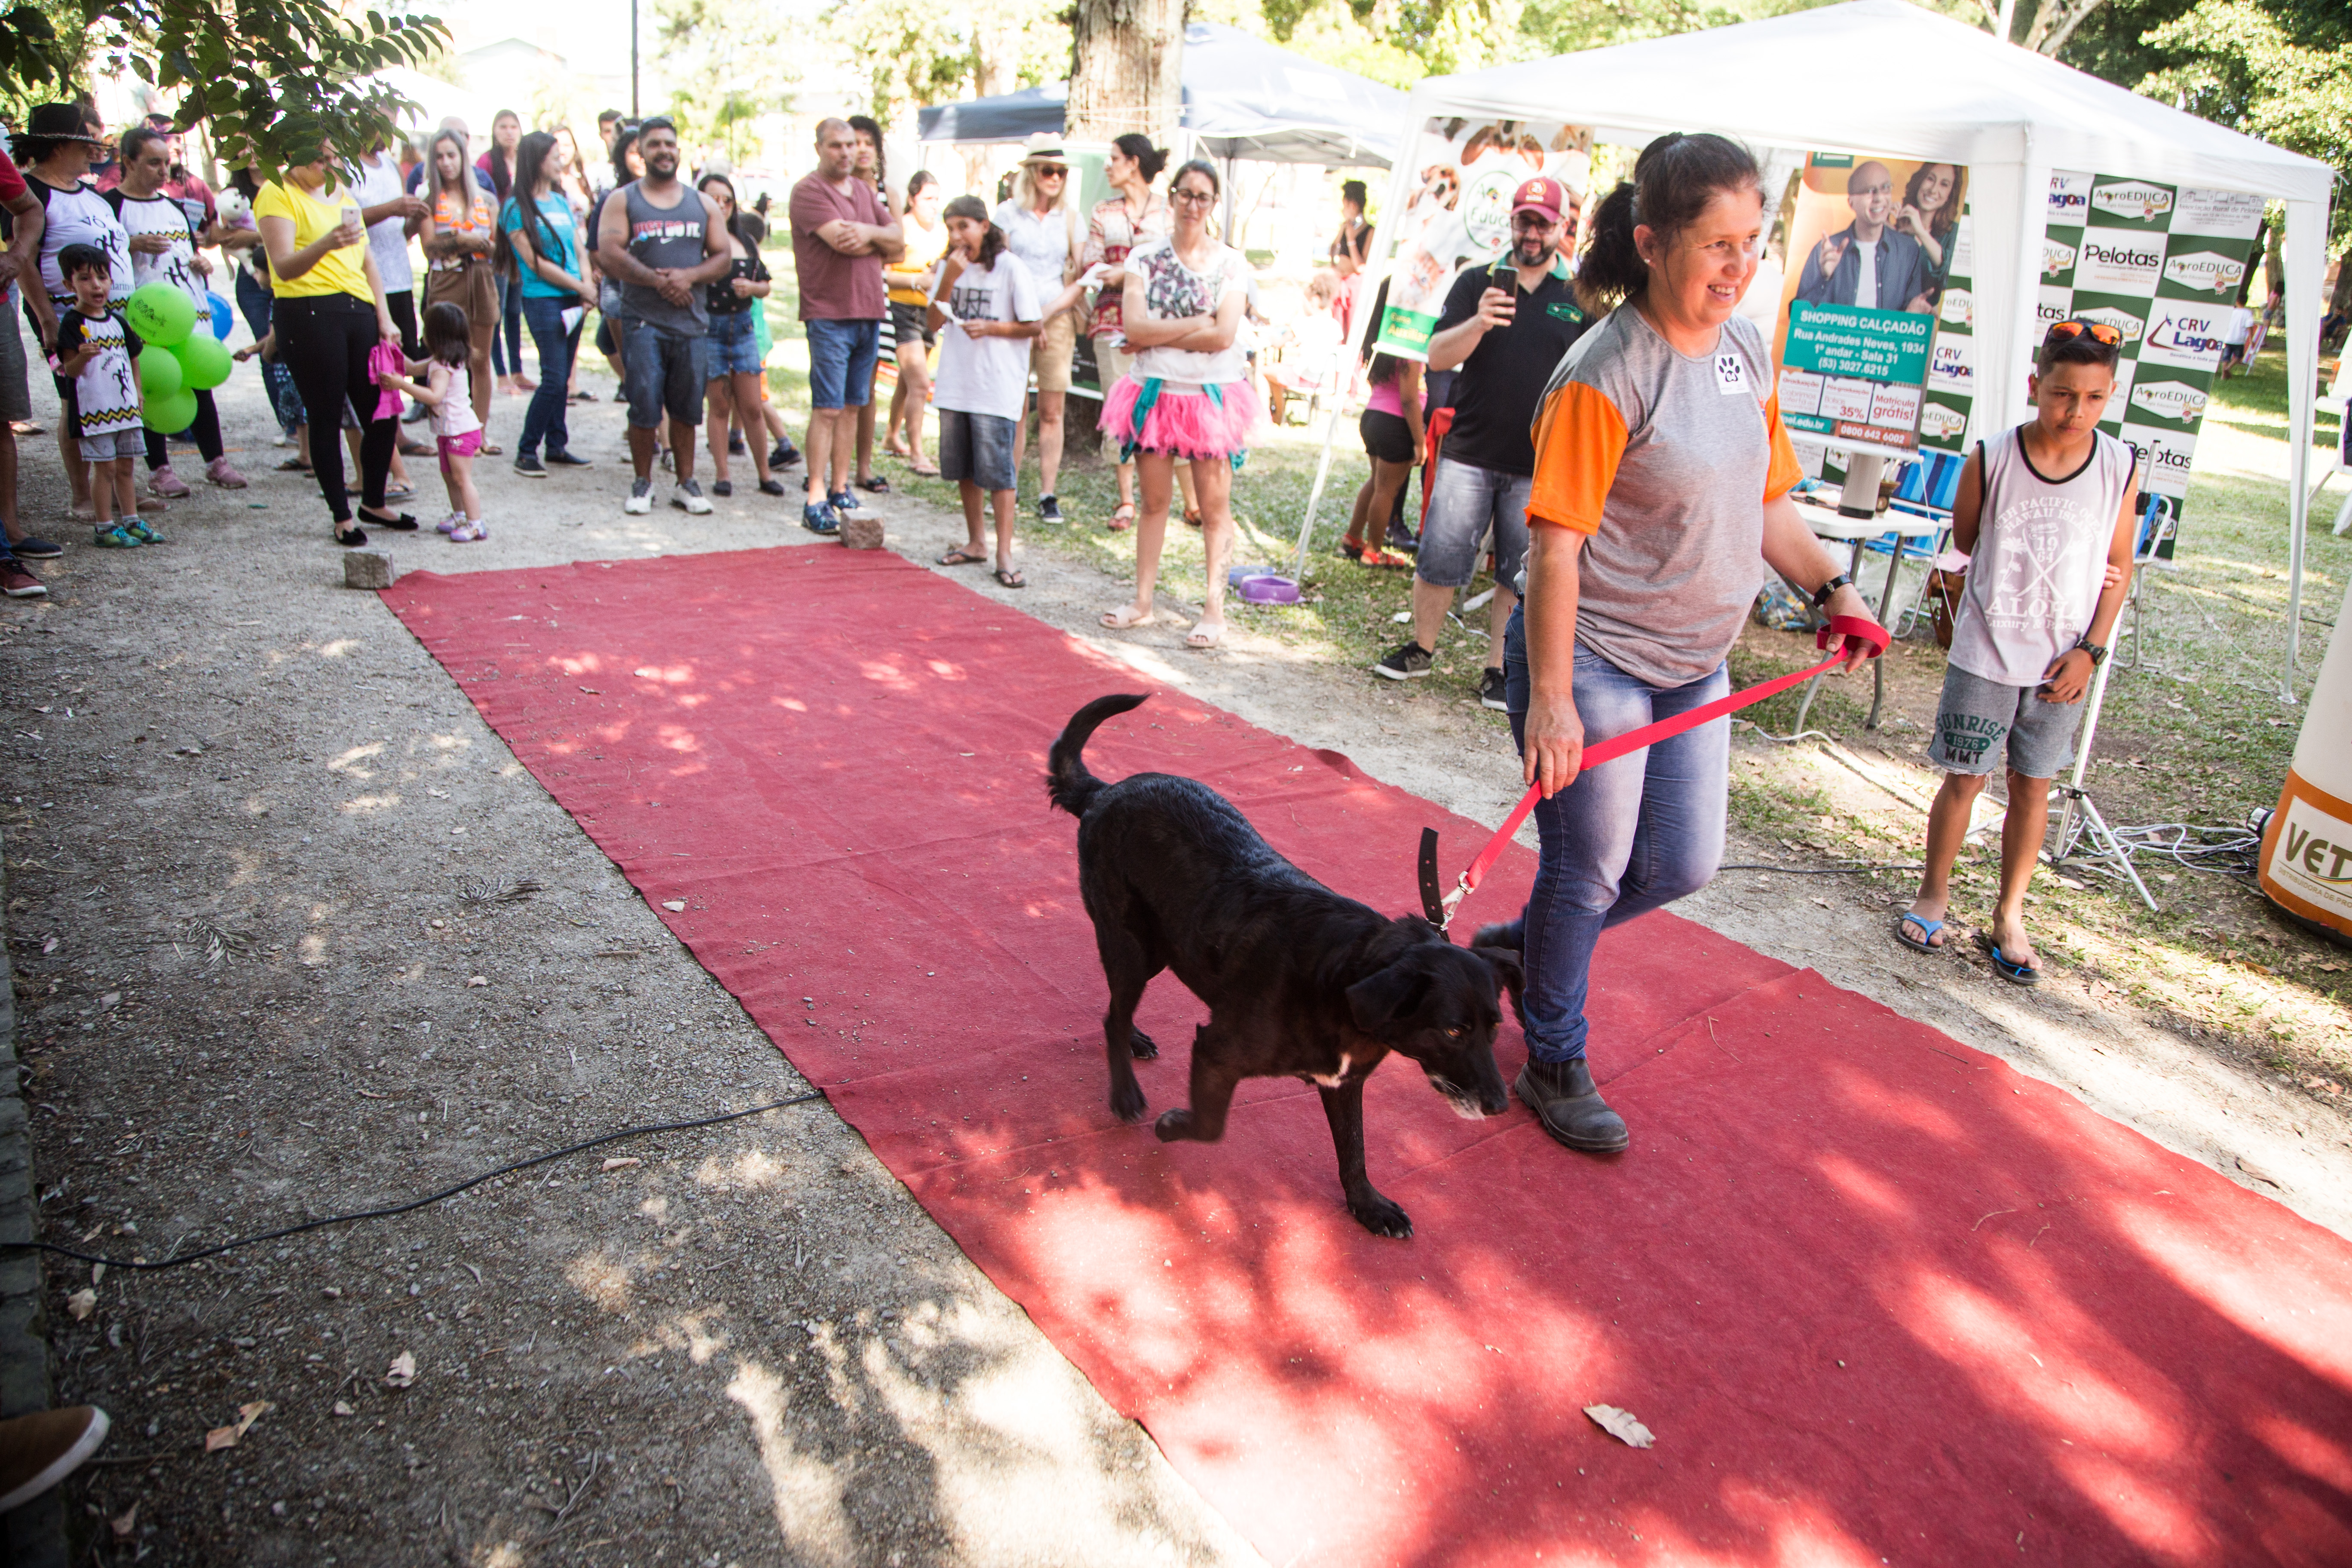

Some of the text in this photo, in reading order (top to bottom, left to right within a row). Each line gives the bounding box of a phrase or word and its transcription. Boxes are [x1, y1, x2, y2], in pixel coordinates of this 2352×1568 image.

[2085, 242, 2159, 267] Pelotas
[1800, 310, 1926, 336] SHOPPING CALÇADÃO
[2178, 318, 2210, 332] CRV
[1794, 328, 1925, 354] Rua Andrades Neves, 1934
[2173, 331, 2223, 352] Lagoa
[1825, 346, 1853, 358] andar
[1861, 349, 1883, 363] Sala
[1886, 353, 1898, 364] 31
[1936, 346, 1962, 360] CRV
[1818, 357, 1889, 377] (53) 3027.6215
[1933, 359, 1973, 377] Lagoa
[1783, 378, 1819, 388] Graduação
[1780, 389, 1816, 400] Cobrimos
[1875, 395, 1915, 407] Matrícula
[1840, 406, 1864, 420] 35%
[1873, 404, 1914, 421] grátis!
[1841, 426, 1905, 444] 0800 642 6002
[2123, 439, 2192, 469] Peotas
[2019, 496, 2078, 512] PACIFIC
[2004, 508, 2054, 533] HAWAII
[2037, 536, 2058, 551] 19
[2037, 551, 2054, 564] 64
[1984, 596, 2084, 620] ALOHA
[1953, 735, 1979, 750] 1976
[1945, 746, 1984, 765] MMT
[2278, 867, 2322, 896] DISTRIBUIDORA
[2324, 891, 2335, 901] DE
